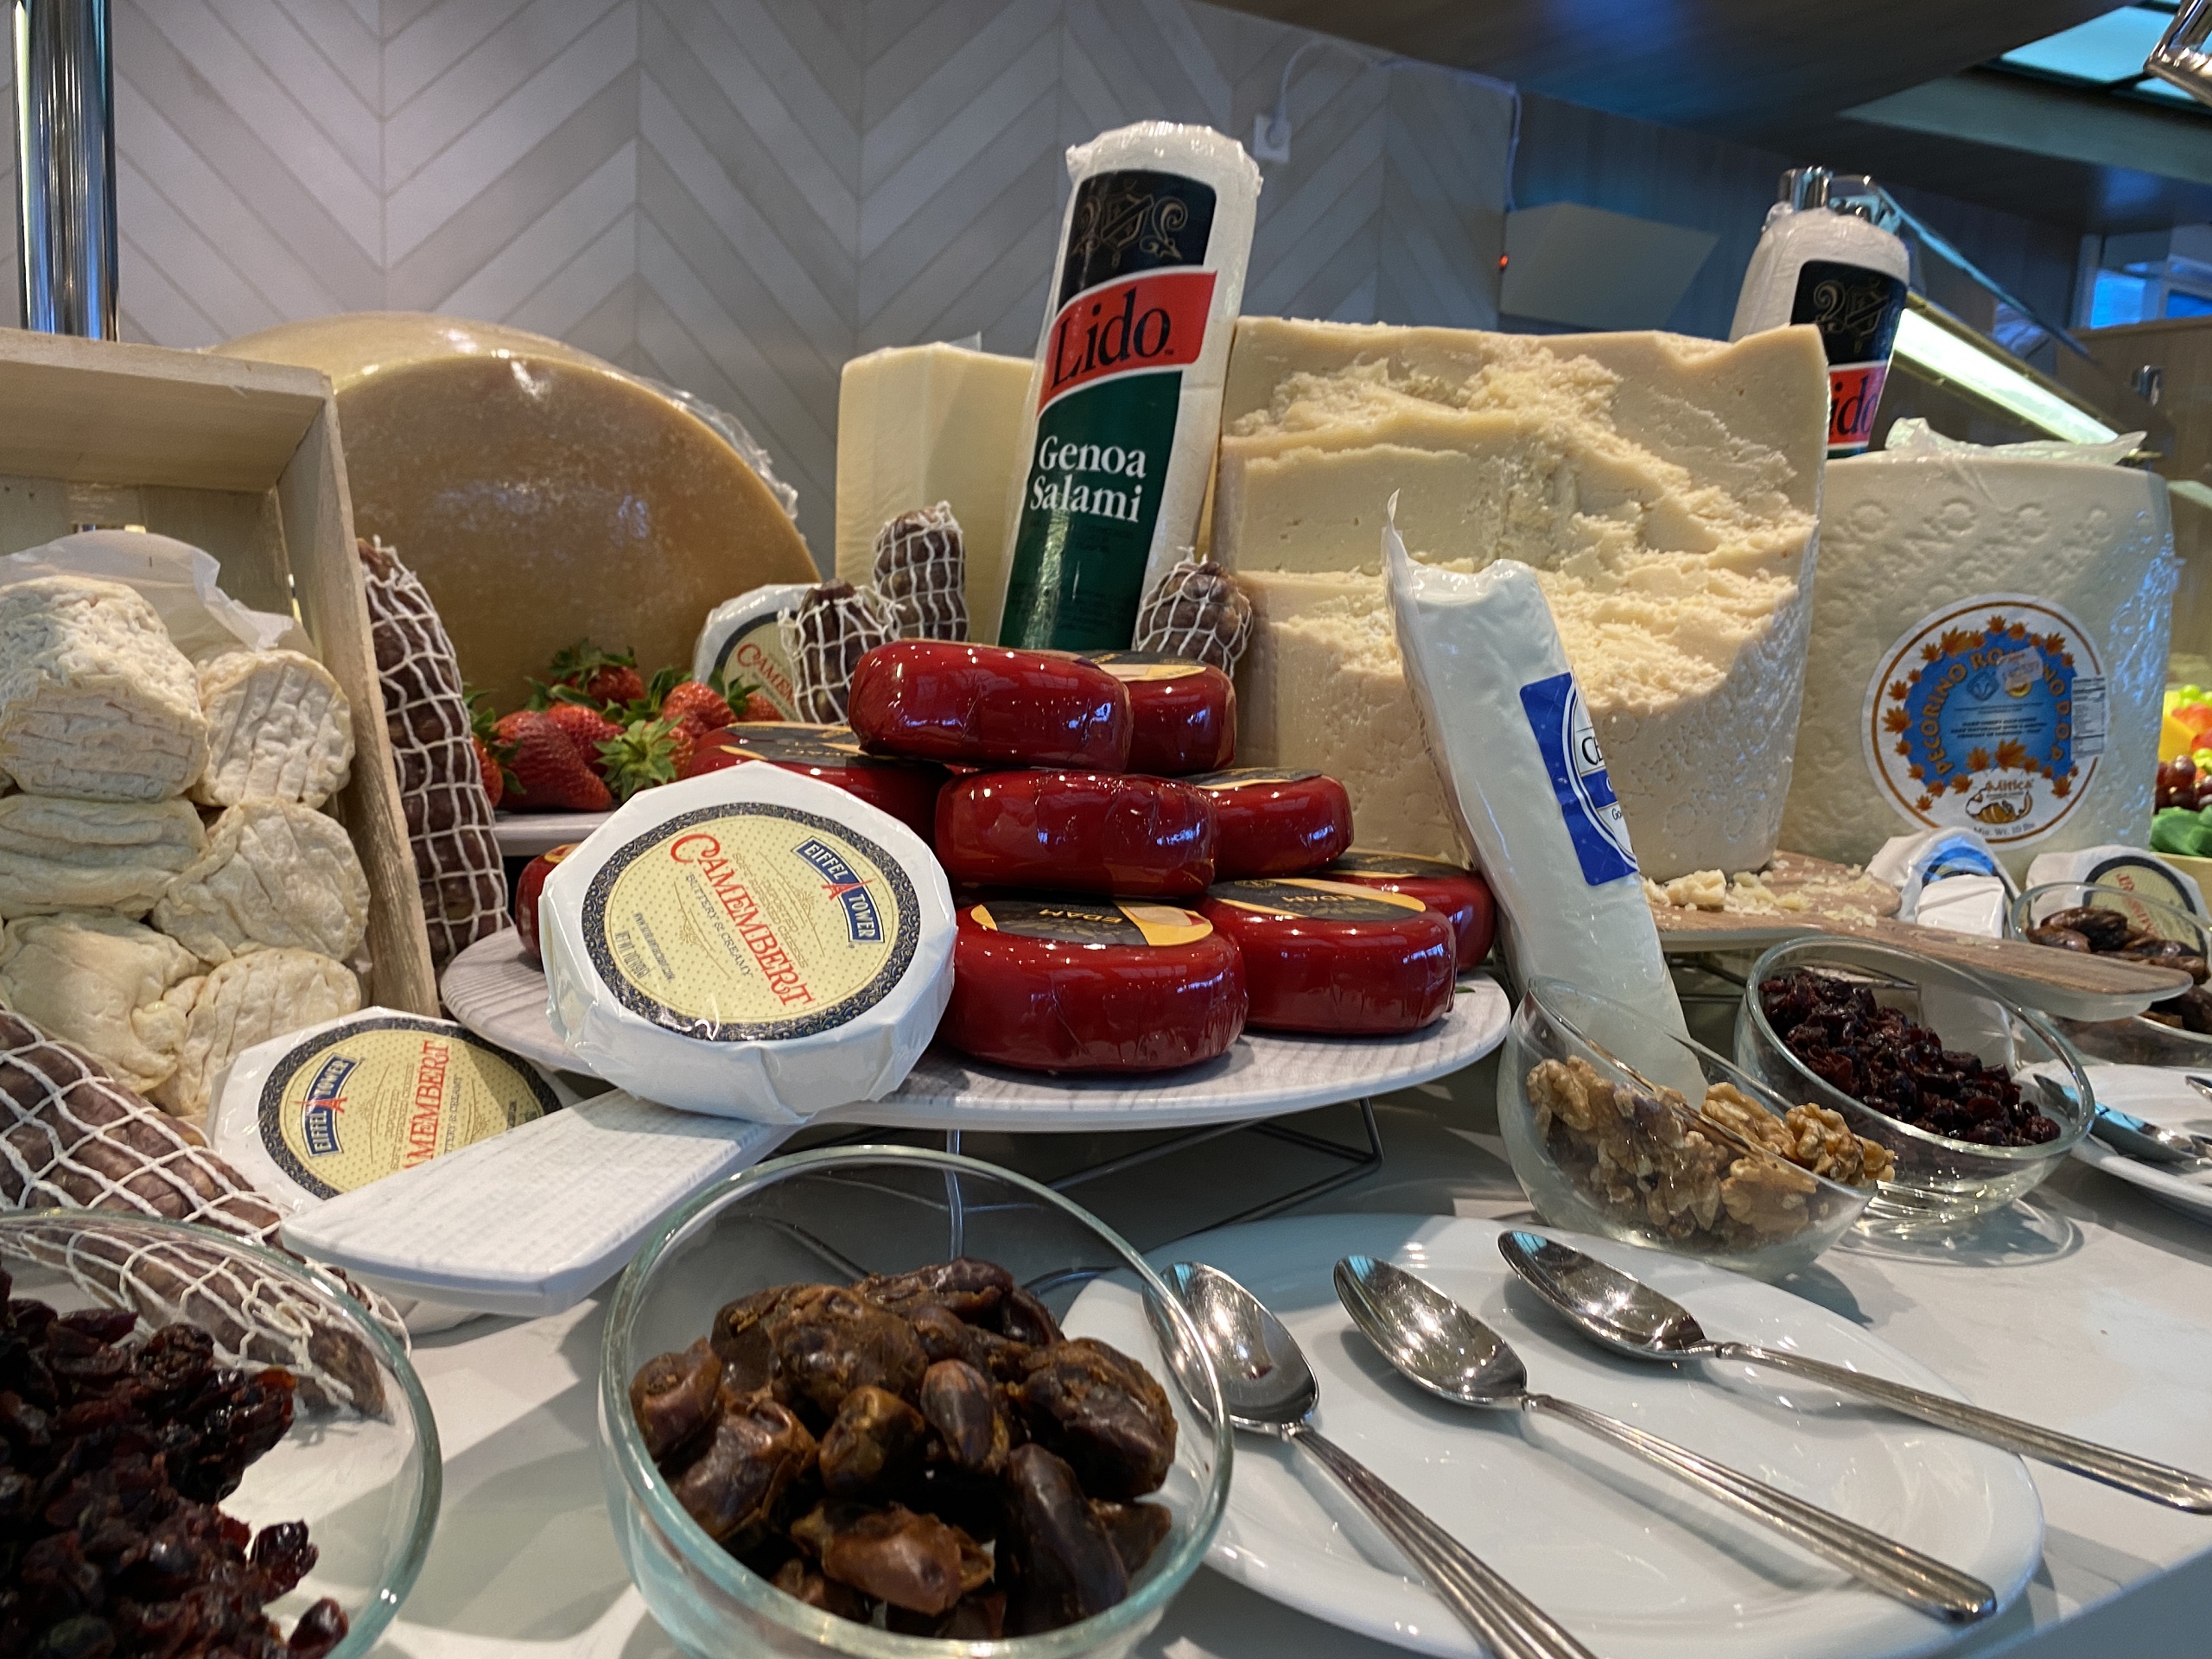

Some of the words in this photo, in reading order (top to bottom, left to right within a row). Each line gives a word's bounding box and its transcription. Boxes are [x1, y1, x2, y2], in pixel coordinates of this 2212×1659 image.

[1051, 286, 1171, 391] Lido
[1030, 474, 1142, 523] Salami
[1039, 435, 1147, 480] Genoa
[1920, 663, 1967, 775] PECORINO
[669, 832, 816, 1007] CAMEMBERT
[686, 873, 719, 919] BUTTERY
[714, 921, 725, 932] &
[721, 931, 753, 978] CREAMY
[732, 852, 753, 878] SOFT
[778, 925, 809, 969] CHEESE
[758, 878, 798, 932] IMPORTED
[804, 843, 849, 880] EIFFEL
[849, 893, 875, 938] TOWER
[314, 1059, 350, 1096] TOWER
[309, 1109, 333, 1152] EIFFEL
